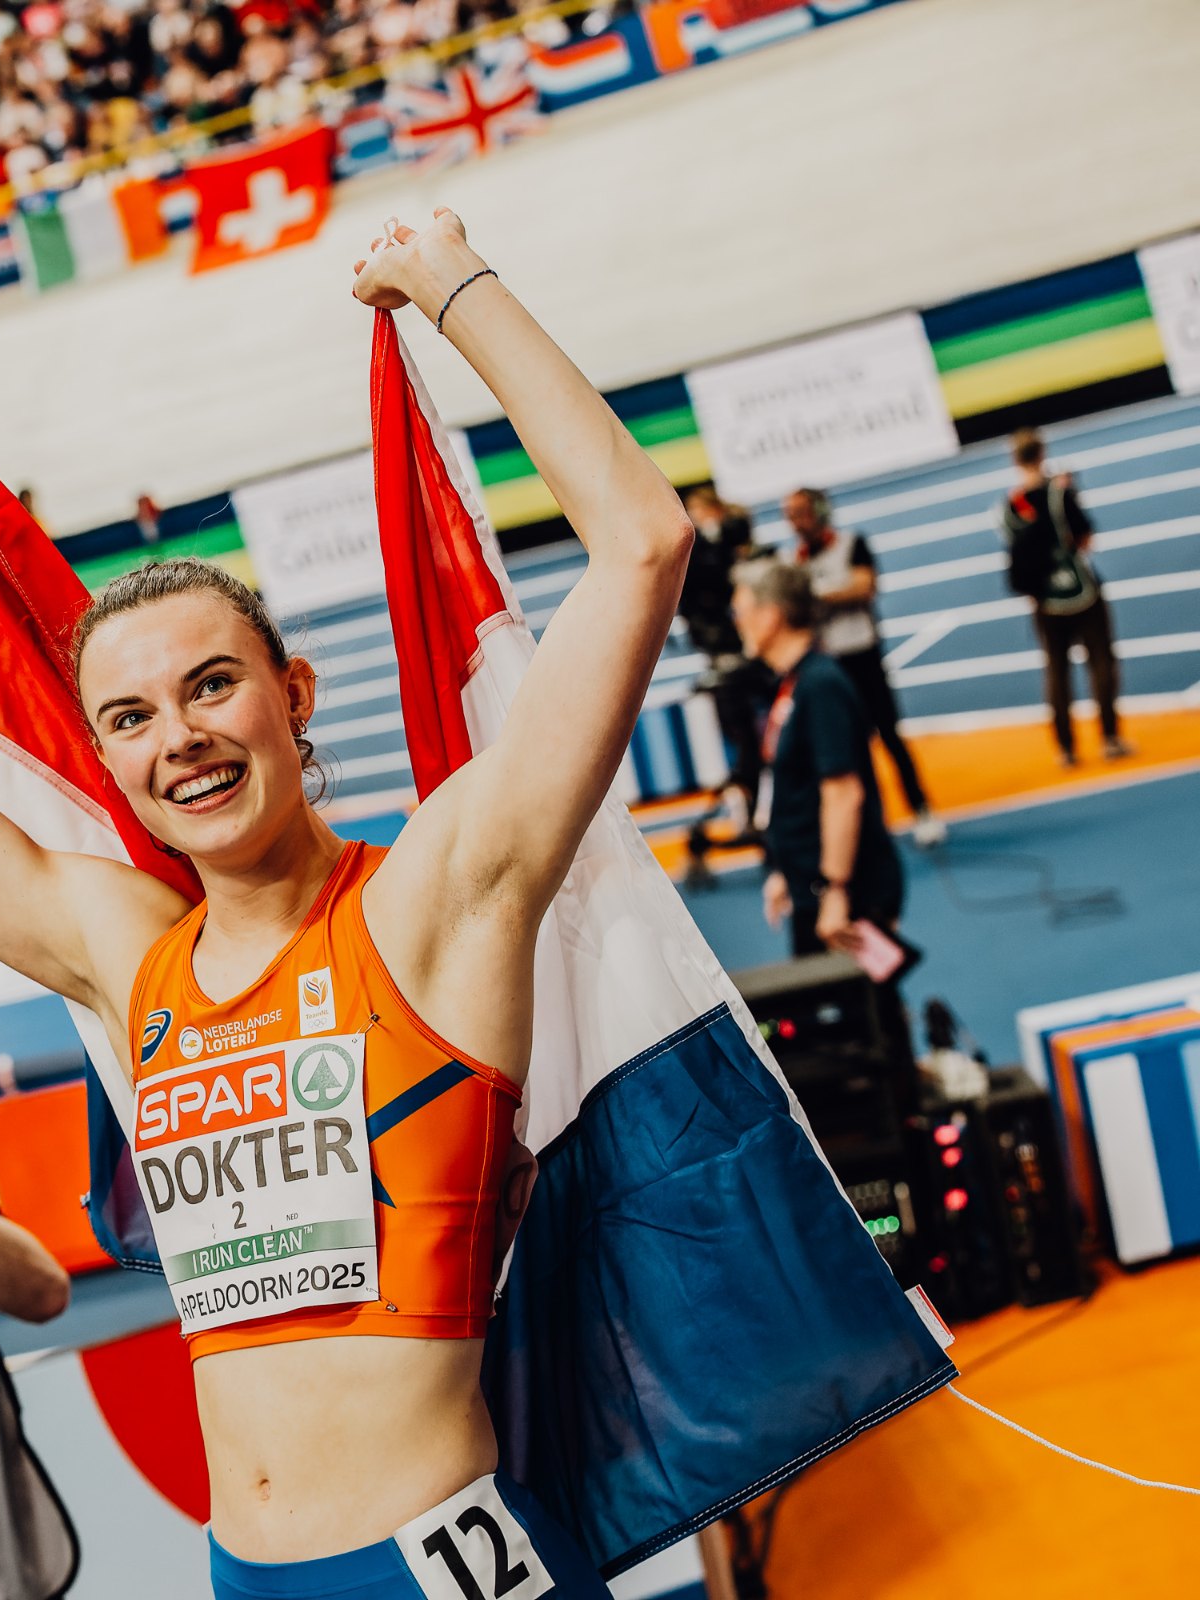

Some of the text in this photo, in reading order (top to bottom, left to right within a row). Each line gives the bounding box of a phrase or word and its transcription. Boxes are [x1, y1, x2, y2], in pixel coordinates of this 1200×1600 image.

[202, 1008, 283, 1040] NEDERLANDSE
[205, 1030, 257, 1054] LOTERIJ
[138, 1062, 283, 1141] SPAR
[141, 1116, 359, 1214] DOKTER
[232, 1201, 247, 1230] 2
[286, 1212, 299, 1222] NED
[199, 1244, 235, 1273] RUN
[180, 1261, 366, 1321] APELDOORN 2025
[421, 1505, 531, 1600] 12
